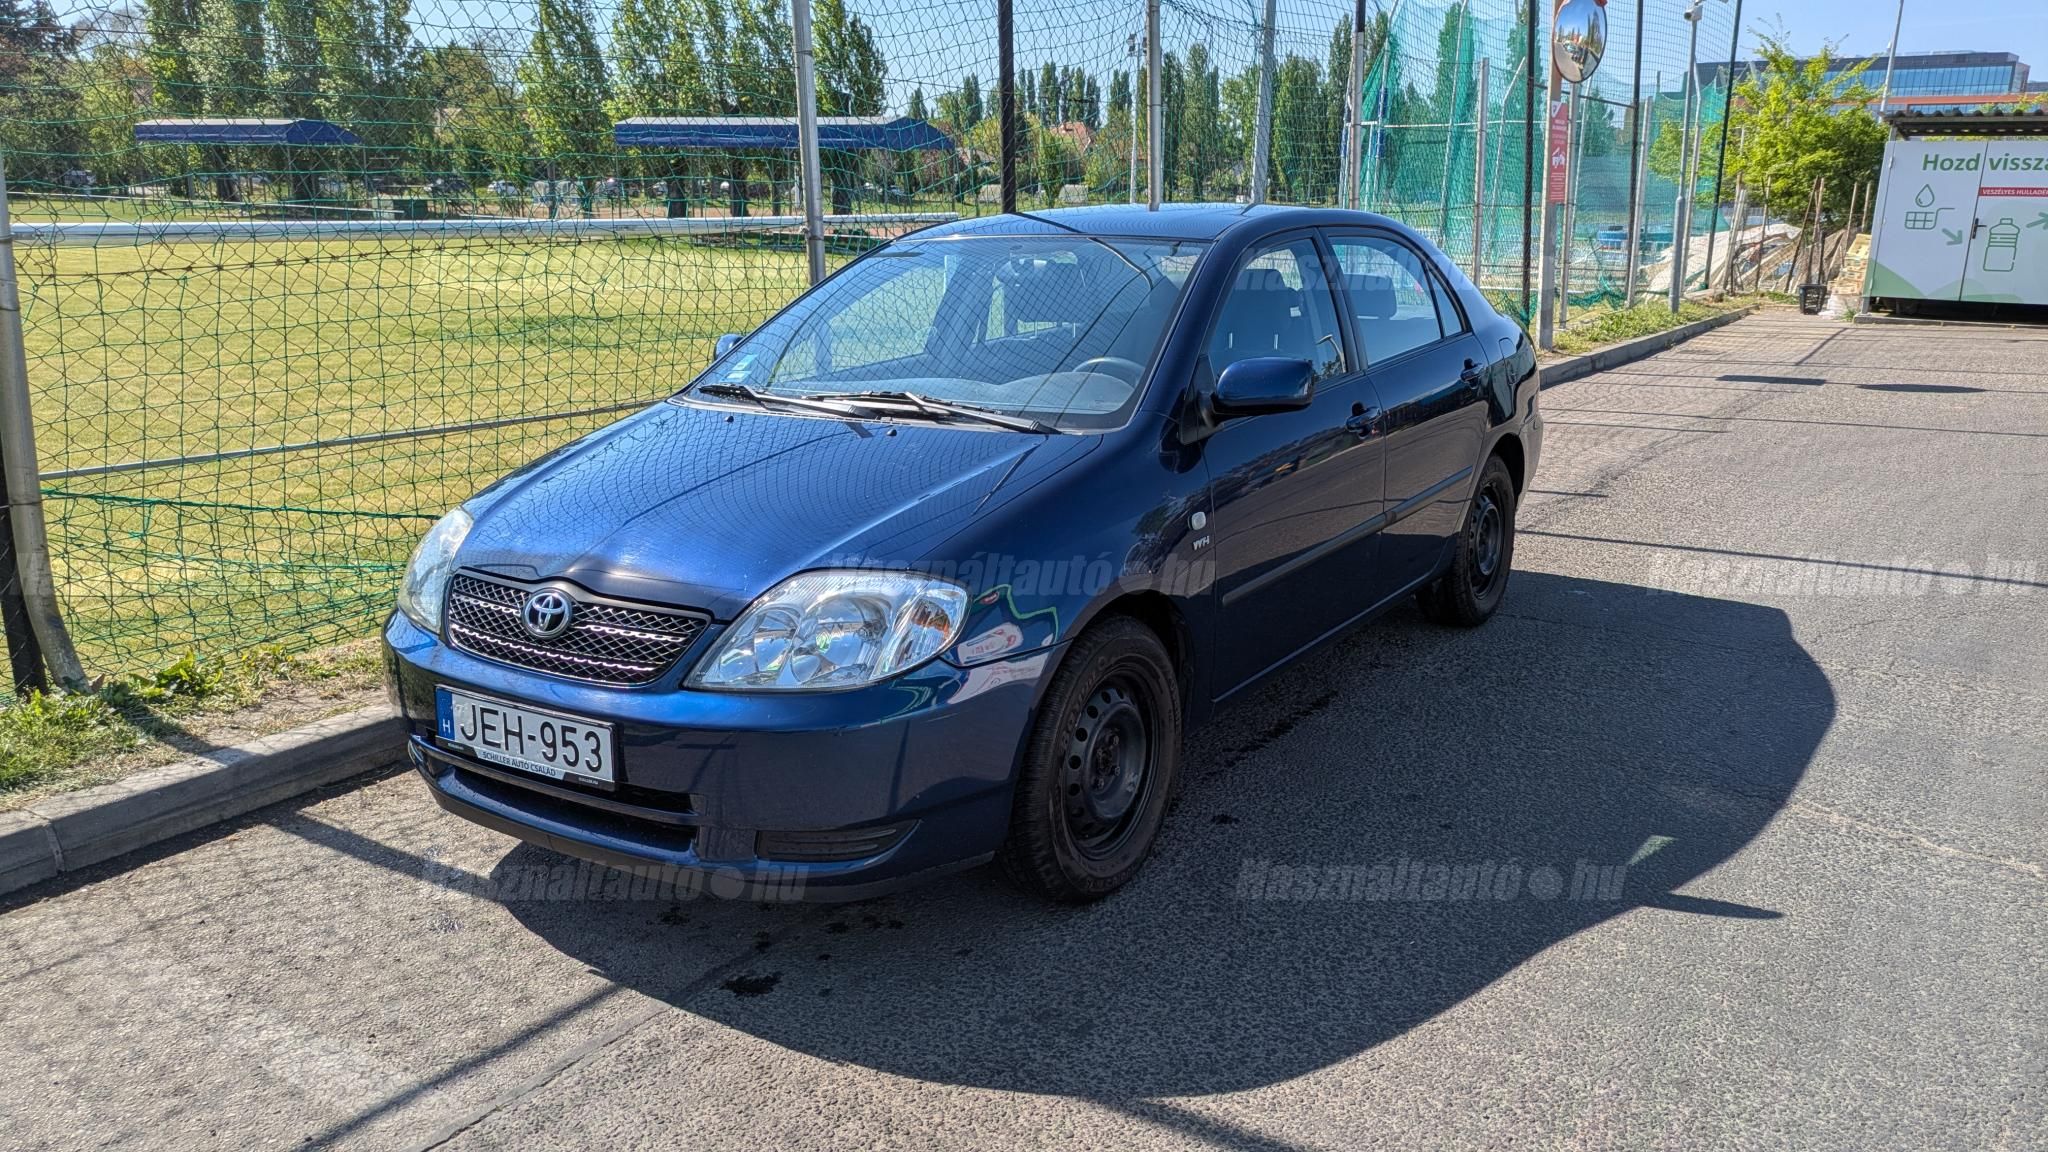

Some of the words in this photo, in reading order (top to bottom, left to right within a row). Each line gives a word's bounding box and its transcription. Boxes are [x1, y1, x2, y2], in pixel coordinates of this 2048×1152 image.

[1922, 153, 1981, 171] Hozd
[442, 718, 451, 733] H
[460, 704, 602, 773] JEH-953
[482, 751, 511, 765] SCHILLER
